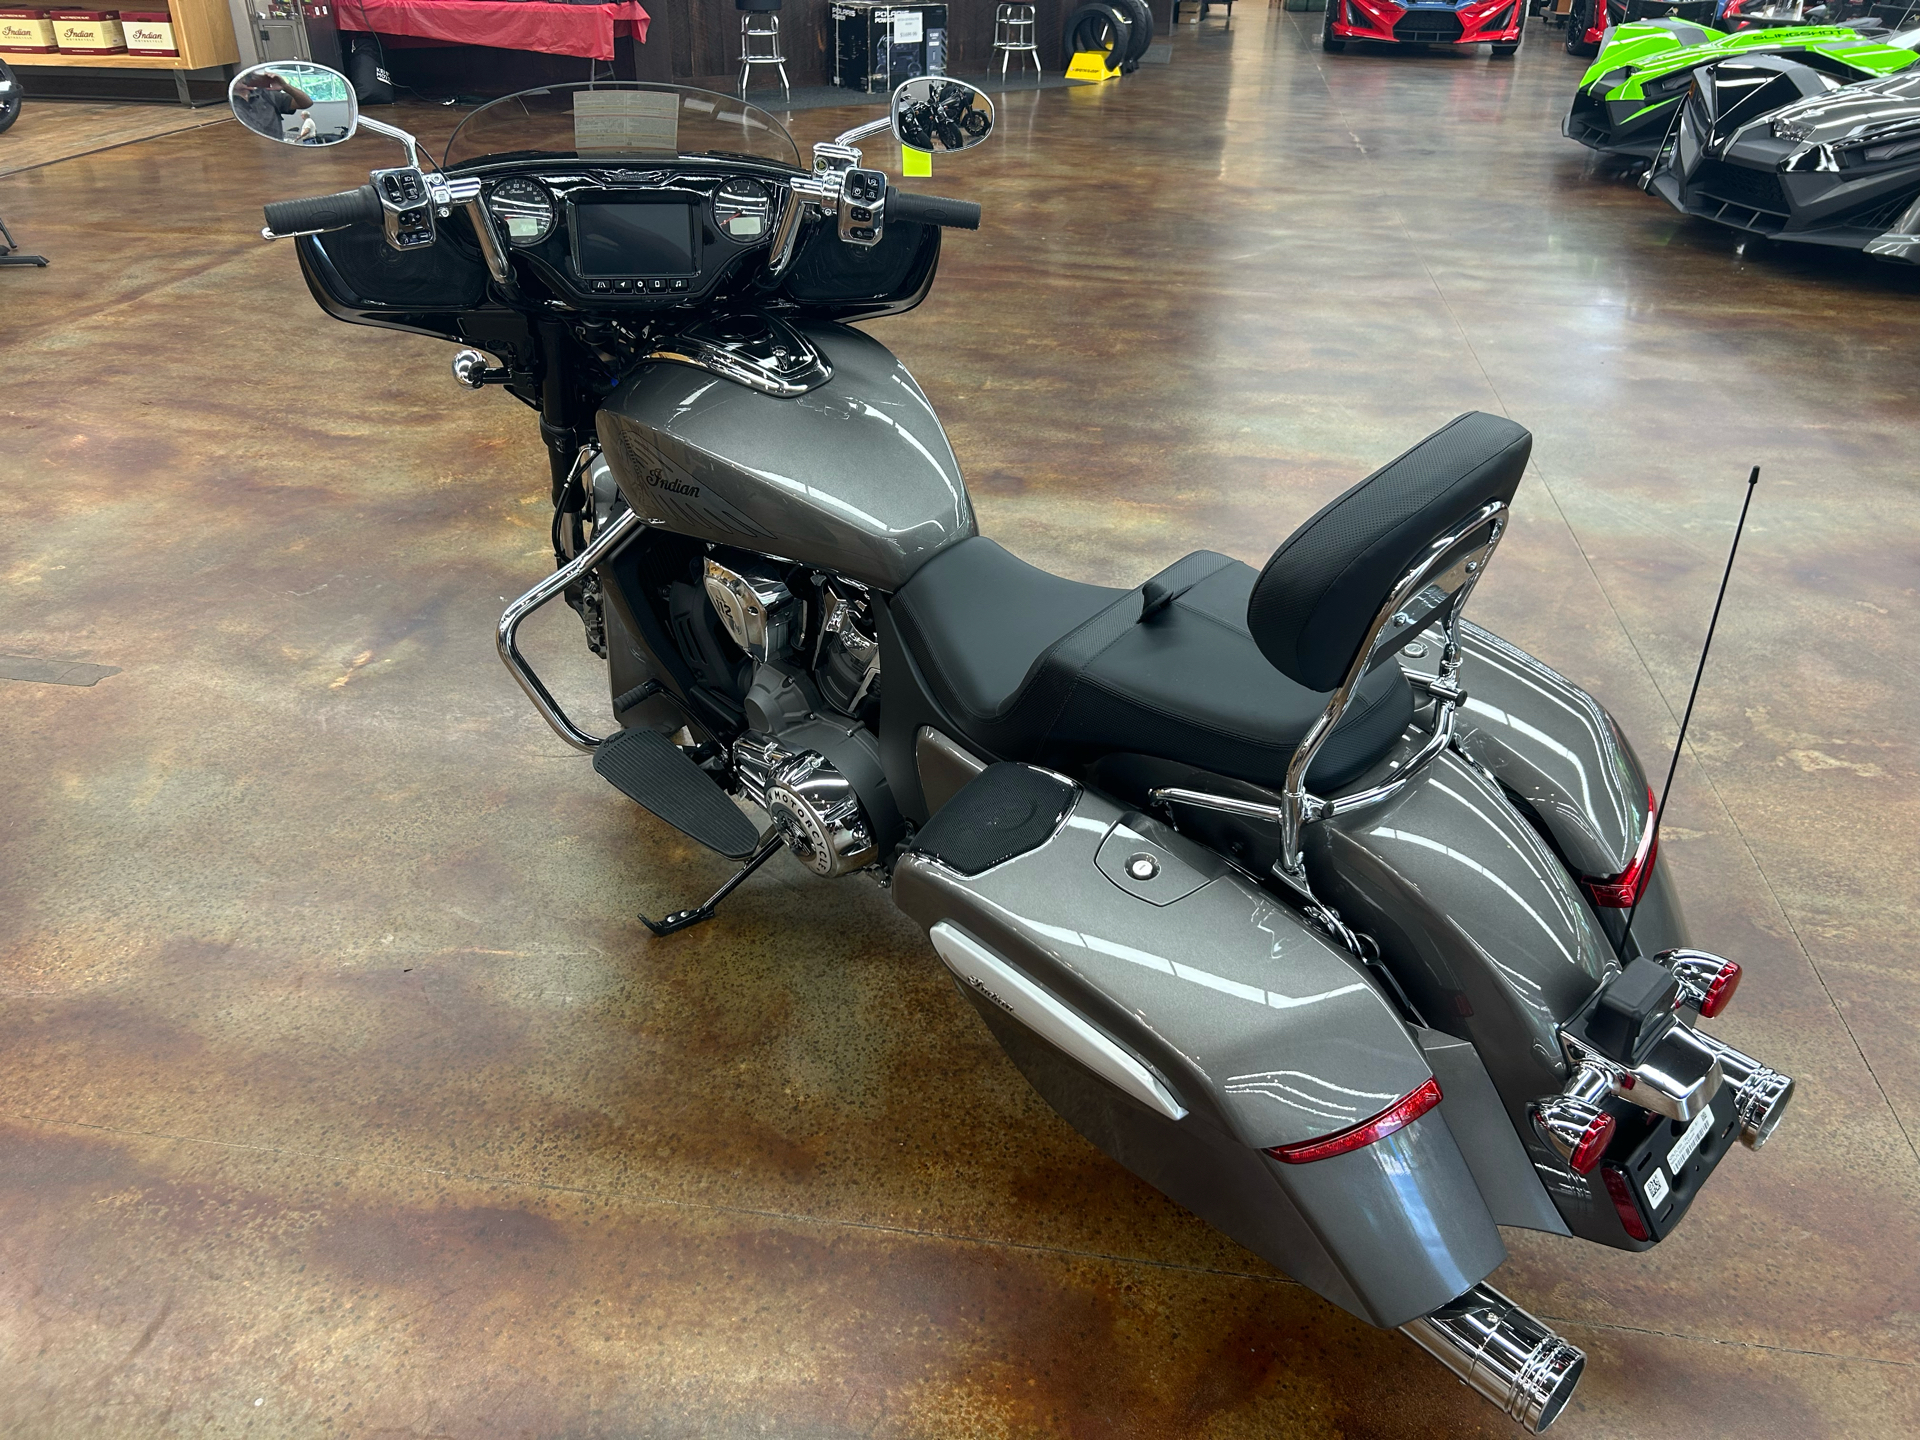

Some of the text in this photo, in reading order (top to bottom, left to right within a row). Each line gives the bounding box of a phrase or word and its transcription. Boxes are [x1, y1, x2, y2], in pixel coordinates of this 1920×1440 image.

[832, 7, 856, 17] POLARIS
[875, 10, 909, 18] POLA
[2, 26, 32, 36] Indian
[64, 28, 94, 38] Indian
[133, 29, 162, 39] Indian
[1753, 30, 1844, 41] SLINGSHOT
[646, 468, 700, 498] Indian
[774, 790, 828, 871] MOTORCYCLE
[967, 975, 1014, 1011] Indian
